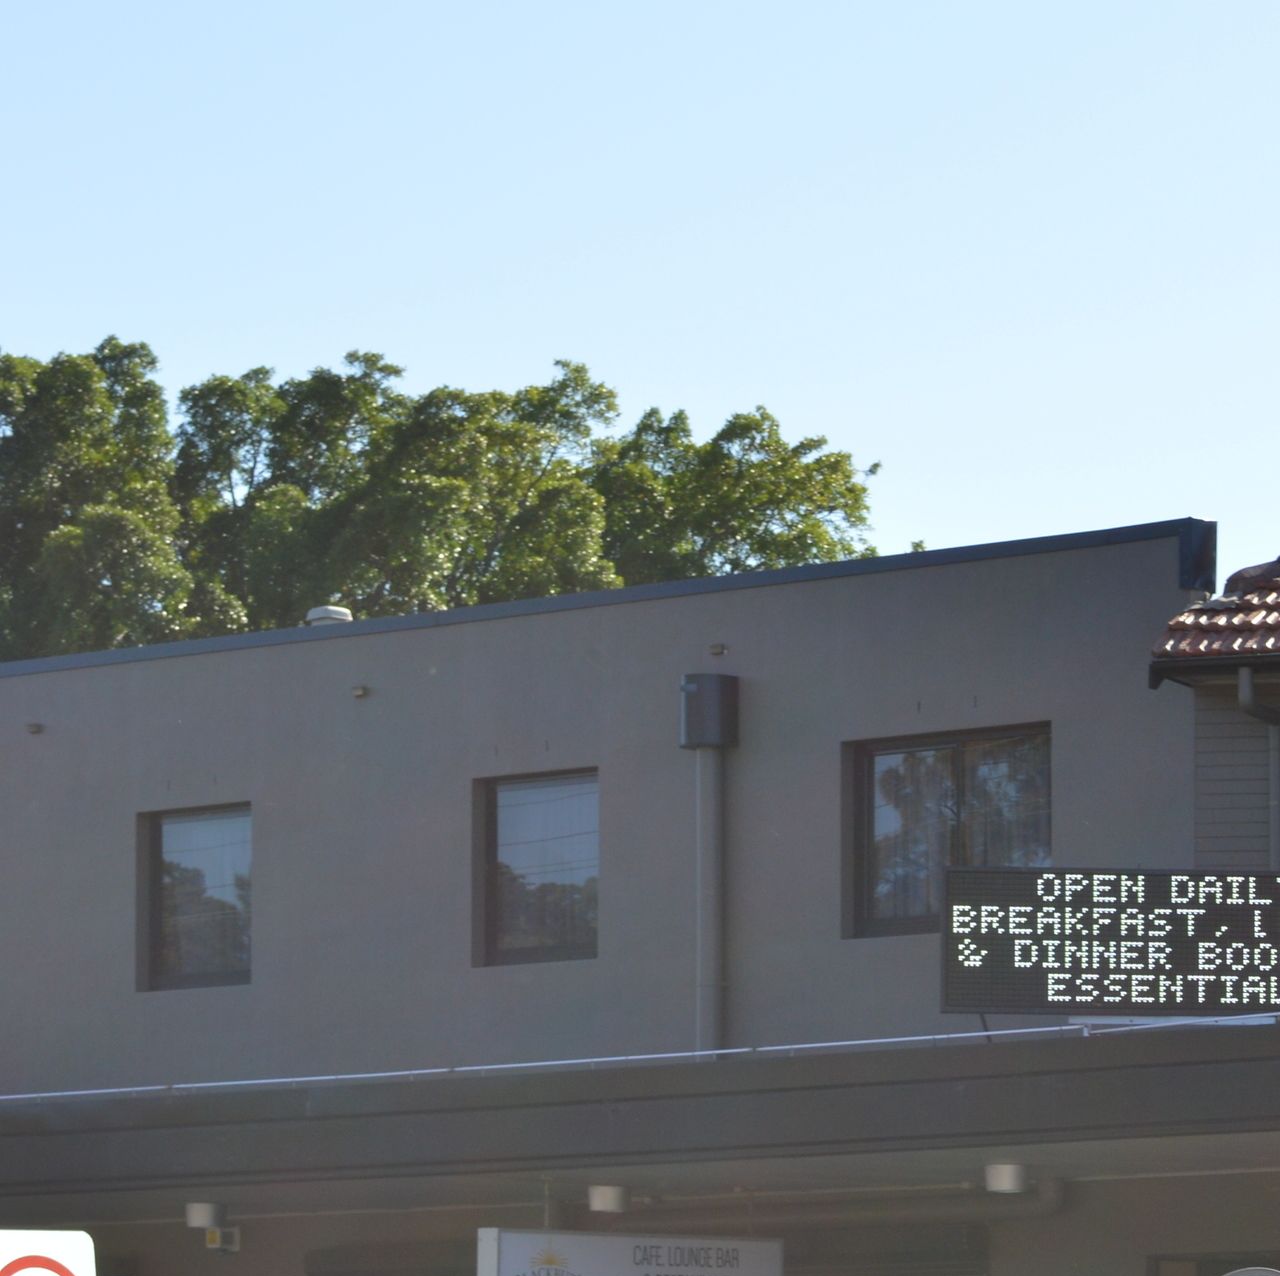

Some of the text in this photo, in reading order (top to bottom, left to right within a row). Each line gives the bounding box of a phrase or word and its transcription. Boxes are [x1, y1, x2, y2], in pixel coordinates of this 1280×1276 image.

[1038, 874, 1145, 903] OPEN
[953, 905, 1228, 938] BREAKFAST,
[957, 939, 988, 967] &
[1015, 940, 1173, 970] DINNER
[668, 1246, 713, 1268] LOUNGE
[716, 1247, 740, 1269] BAR
